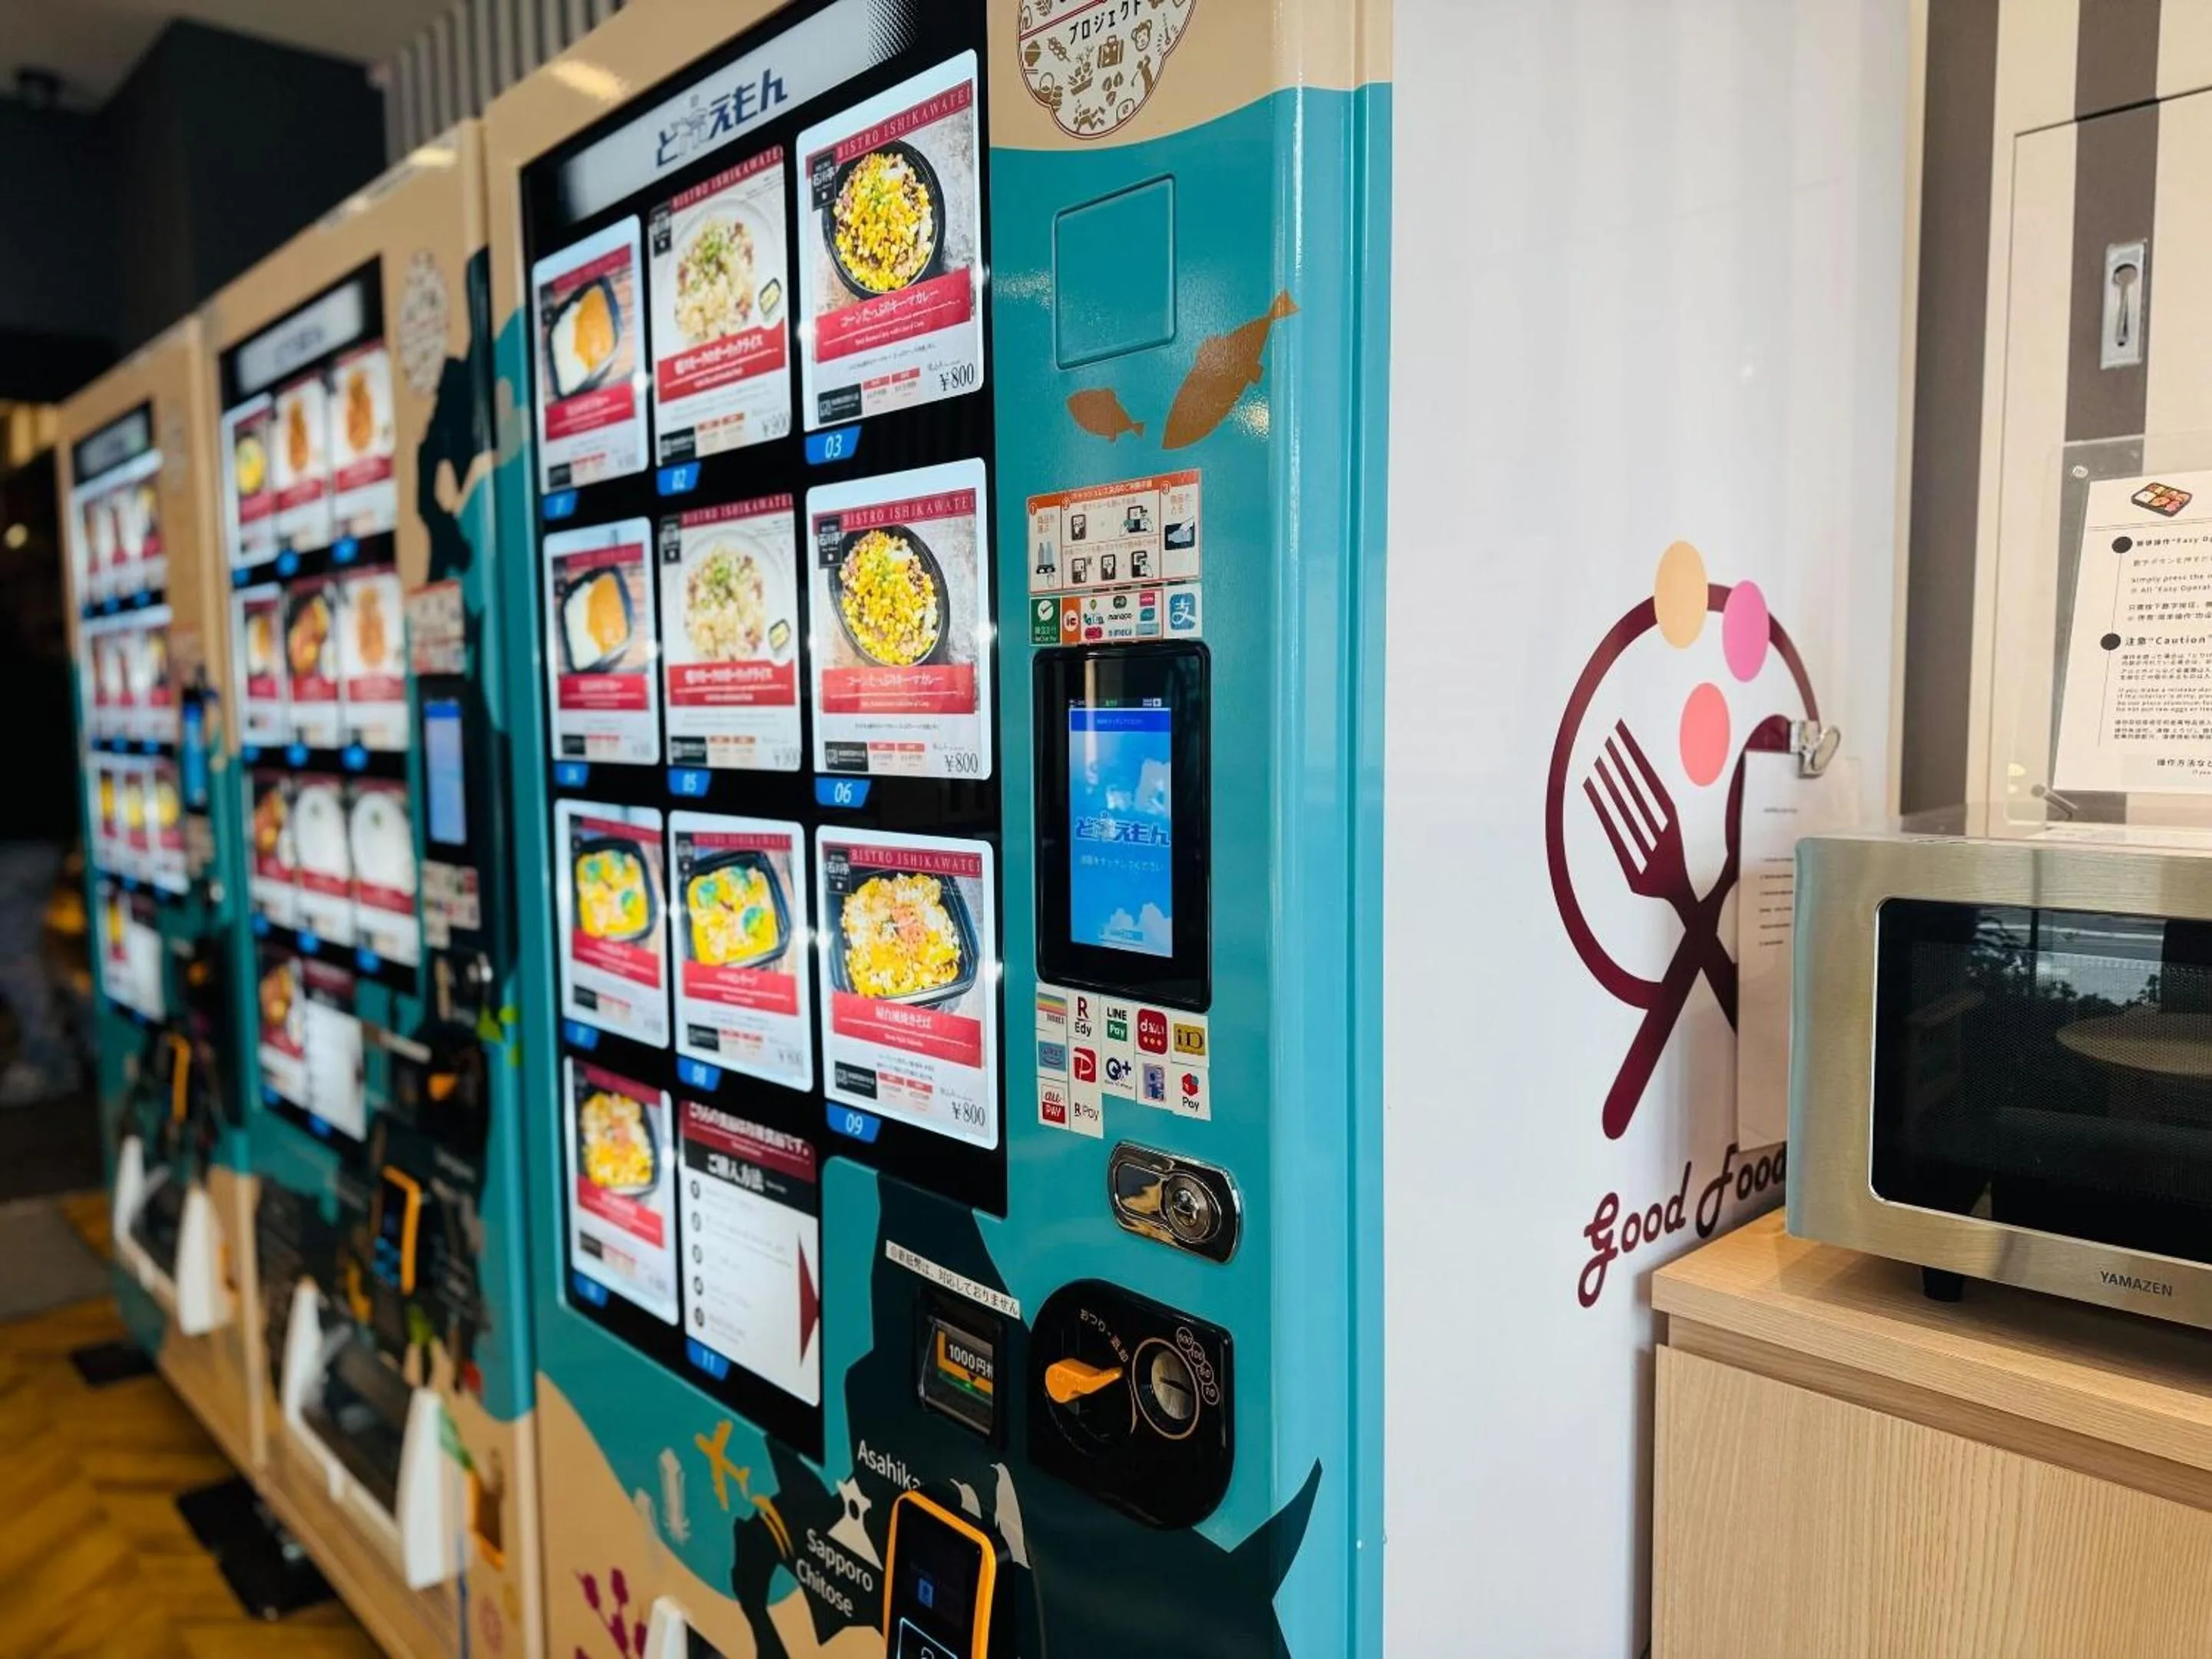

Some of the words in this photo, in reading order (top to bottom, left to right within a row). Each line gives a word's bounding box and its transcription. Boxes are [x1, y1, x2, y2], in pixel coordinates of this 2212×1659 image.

[1068, 0, 1141, 45] プロジェクト
[837, 131, 878, 158] BISTRO
[884, 86, 971, 137] ISHIKAWATEI
[939, 363, 975, 392] ¥800
[825, 435, 843, 459] 03
[843, 509, 884, 526] BISTRO
[889, 495, 975, 520] ISHIKAWATEI
[944, 752, 979, 773] ¥800
[833, 782, 853, 803] 06
[850, 848, 892, 864] BISTRO
[897, 853, 981, 873] ISHIKAWATEI
[1107, 1006, 1128, 1021] LINE
[1075, 1022, 1092, 1037] Edy
[1109, 1024, 1125, 1037] Pay
[1177, 1029, 1203, 1049] iD
[952, 1101, 985, 1127] ¥800
[1045, 1104, 1061, 1117] PAY
[1182, 1097, 1200, 1111] Pay
[846, 1114, 863, 1135] 09
[1578, 1161, 1692, 1309] Good
[2100, 1270, 2173, 1297] YAMAZEN
[806, 1528, 873, 1592] Sapporo
[796, 1559, 854, 1617] Chitose
